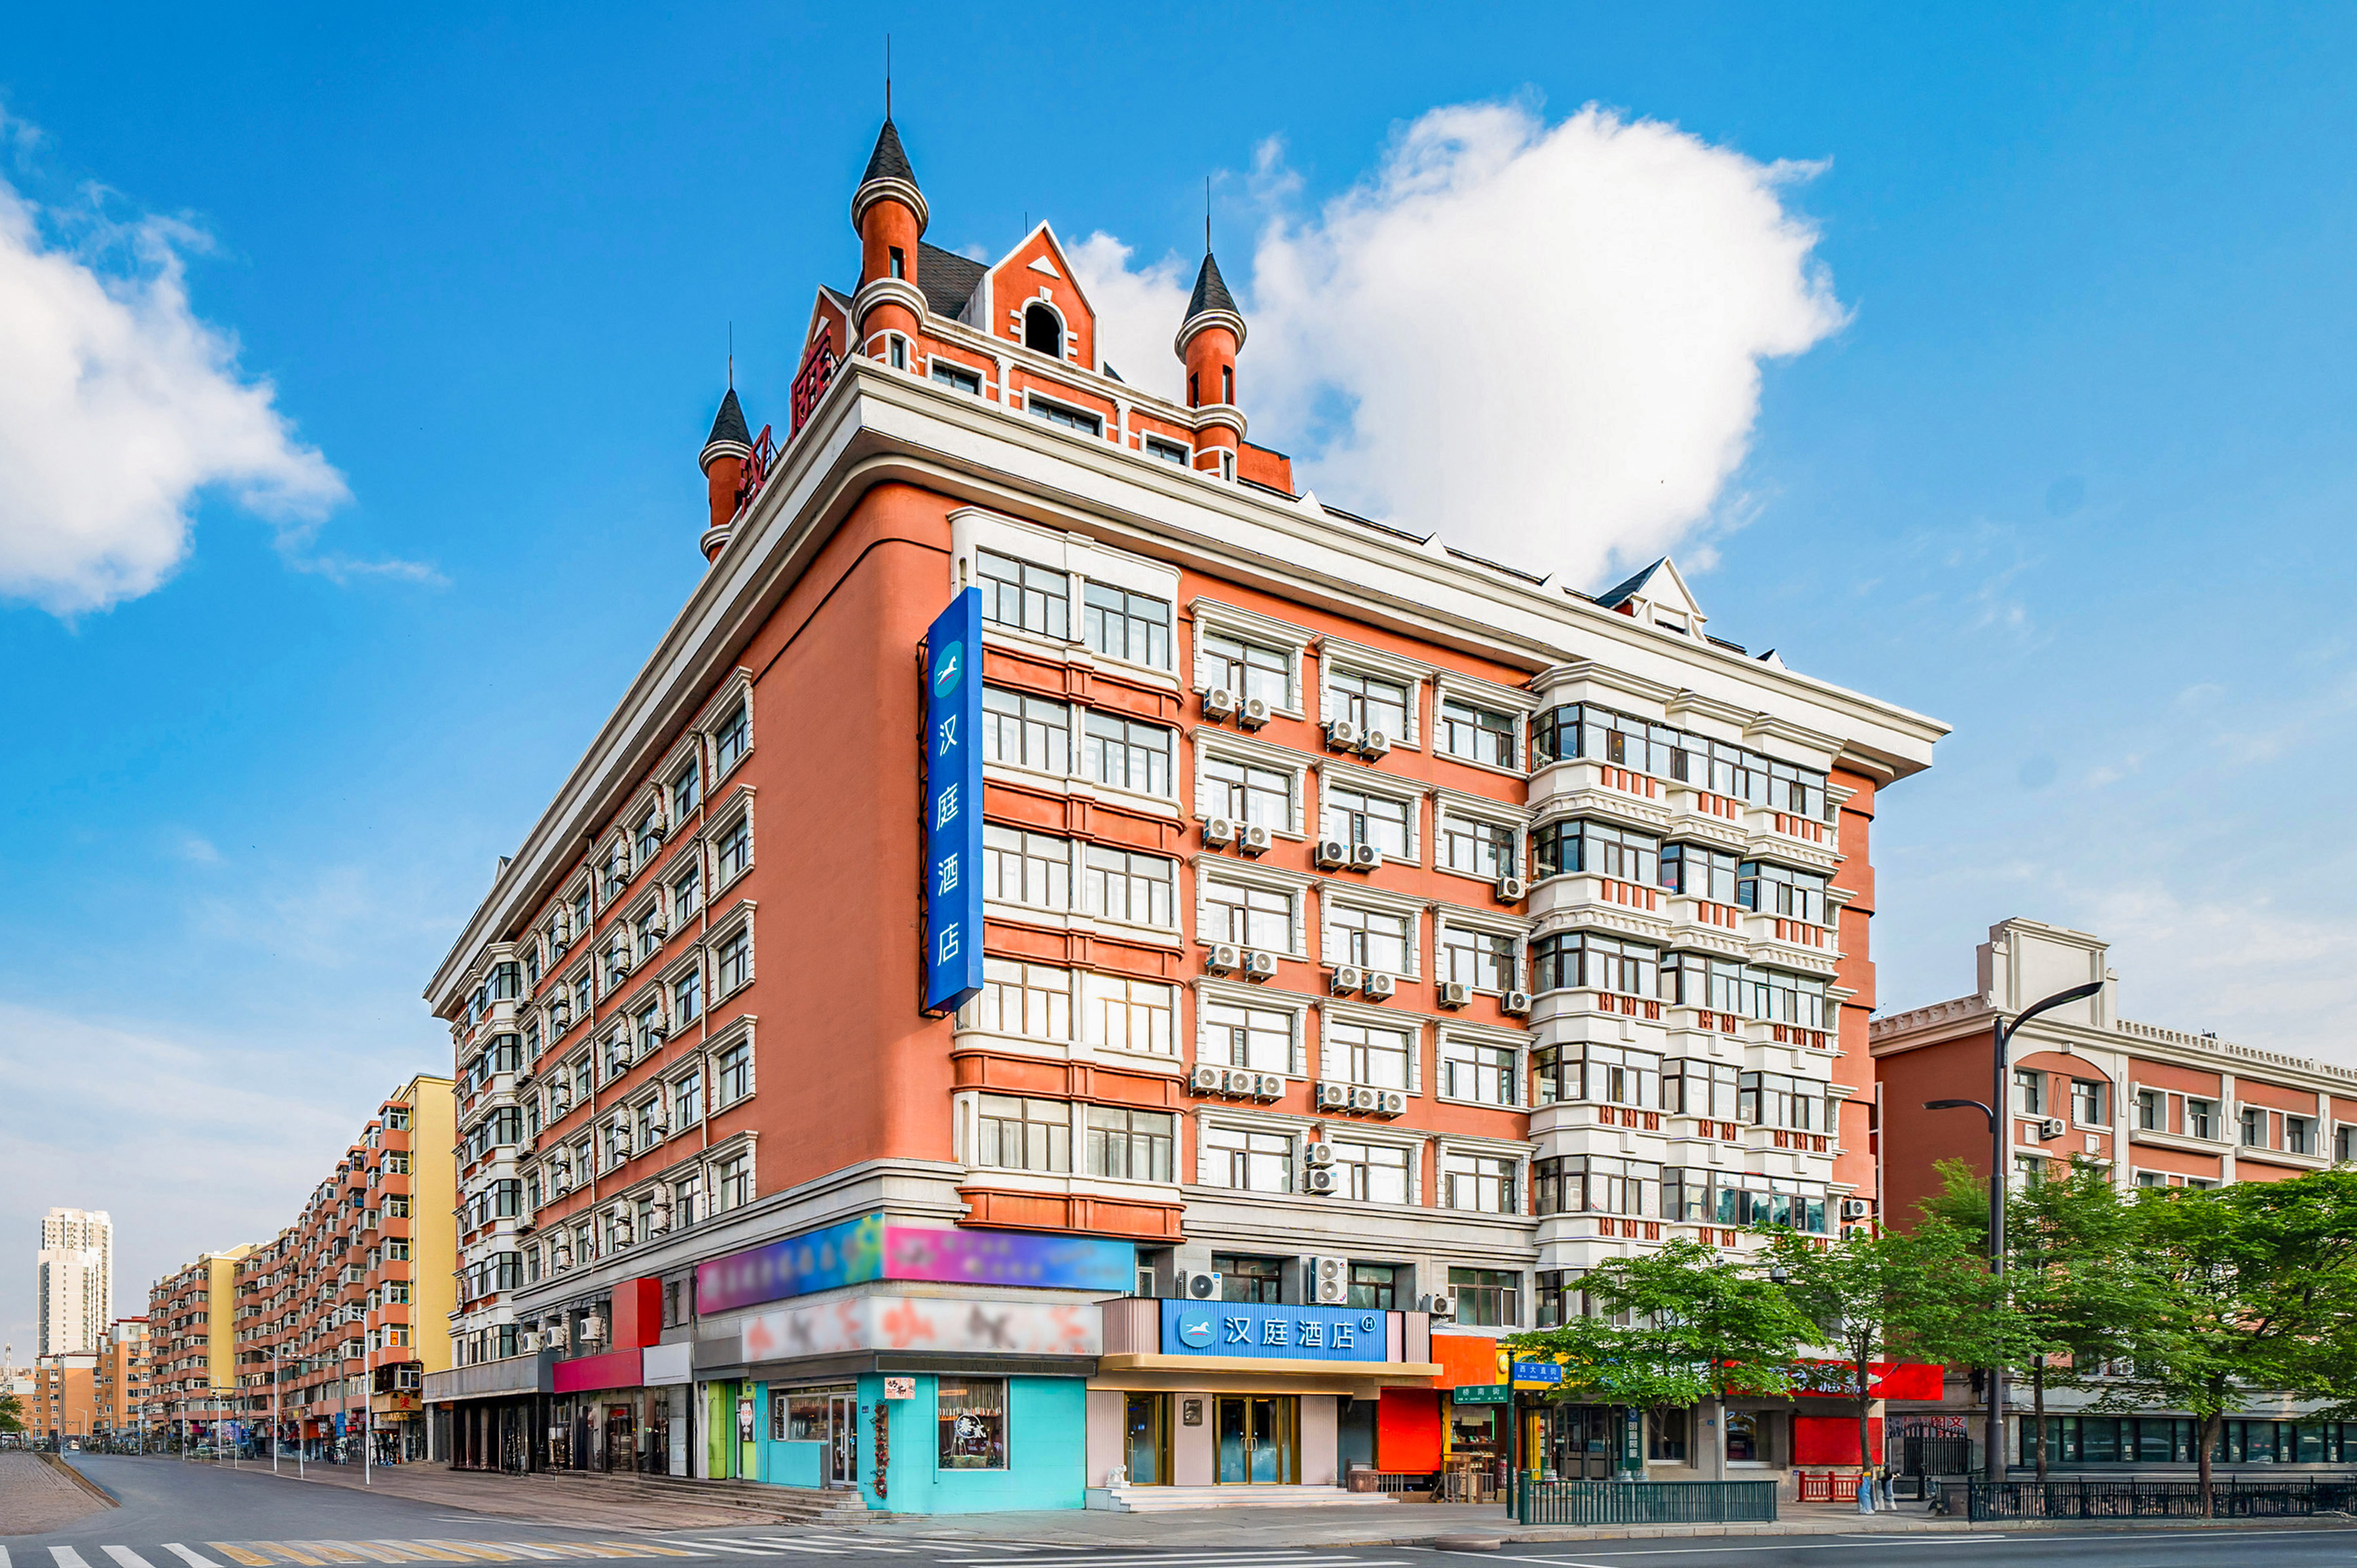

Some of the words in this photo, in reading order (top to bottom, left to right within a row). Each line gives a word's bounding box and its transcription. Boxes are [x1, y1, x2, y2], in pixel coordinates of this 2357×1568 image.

[936, 714, 959, 967] 汉庭酒店
[1224, 1317, 1355, 1349] 汉庭酒店
[1520, 1365, 1557, 1376] 西大直街
[1463, 1387, 1500, 1396] 桥南街
